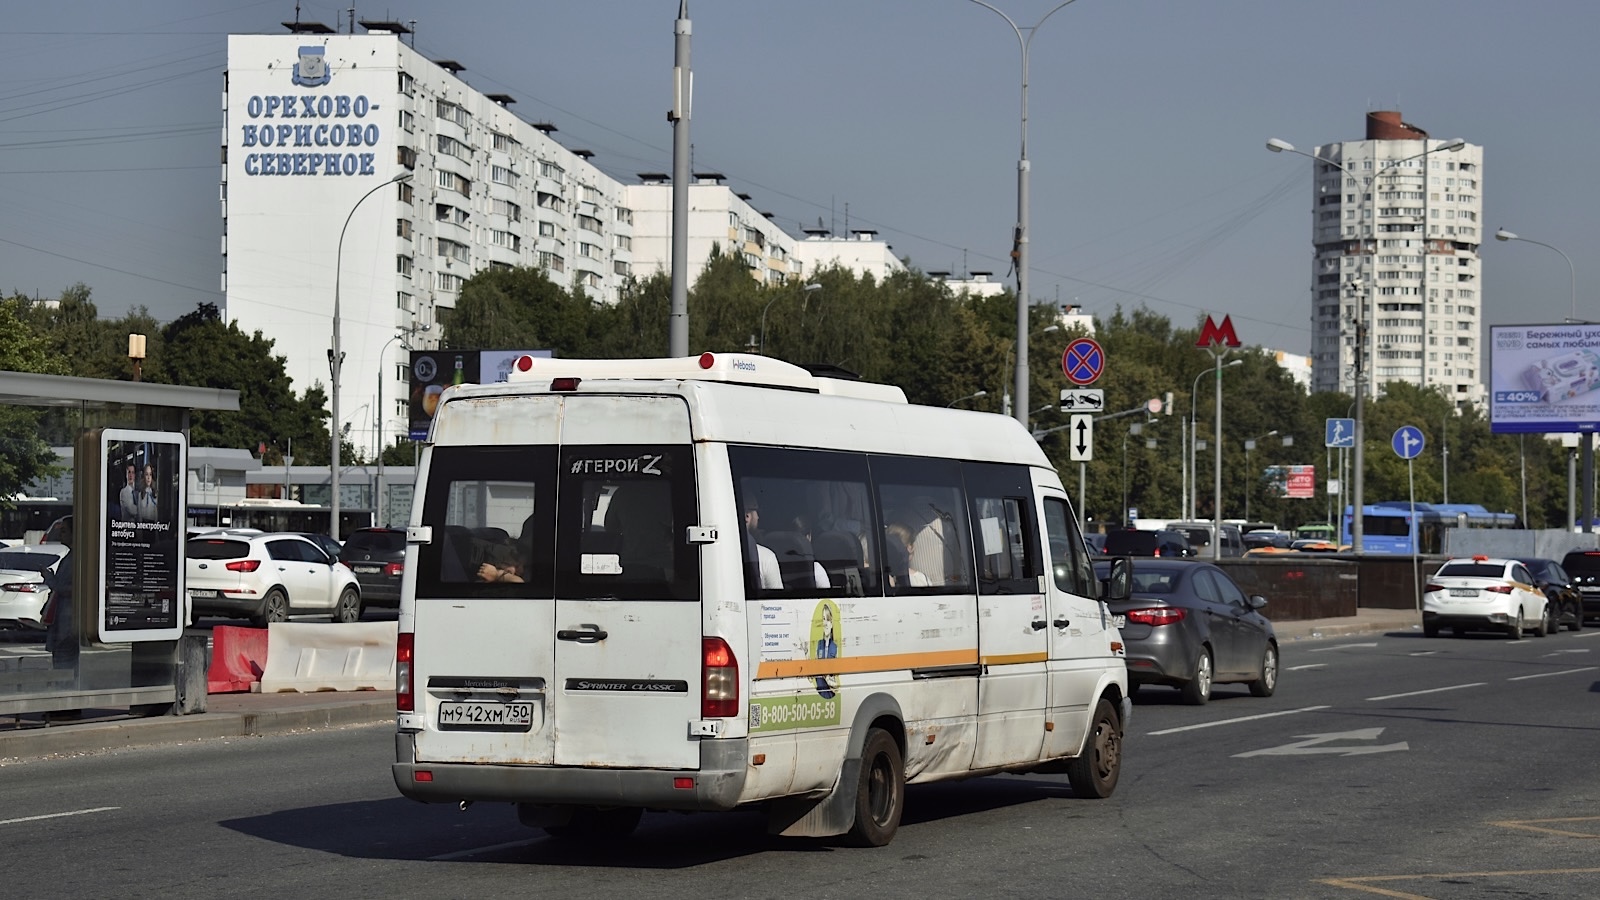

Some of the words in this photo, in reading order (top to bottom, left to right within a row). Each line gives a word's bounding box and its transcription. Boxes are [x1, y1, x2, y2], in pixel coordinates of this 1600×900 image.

[247, 95, 380, 119] ОРЕХОВО-
[241, 123, 380, 147] БОРИСОВО
[244, 153, 375, 176] СЕВЕРНОЕ
[1526, 330, 1582, 340] Бережный
[1526, 341, 1560, 349] самых
[1562, 339, 1600, 348] любим
[111, 519, 136, 530] Водитель
[137, 521, 171, 532] электробуса/
[111, 529, 135, 539] автобуса
[577, 681, 627, 690] SPRINTER
[505, 705, 528, 718] 750
[762, 701, 836, 724] 8-800-500-05-58
